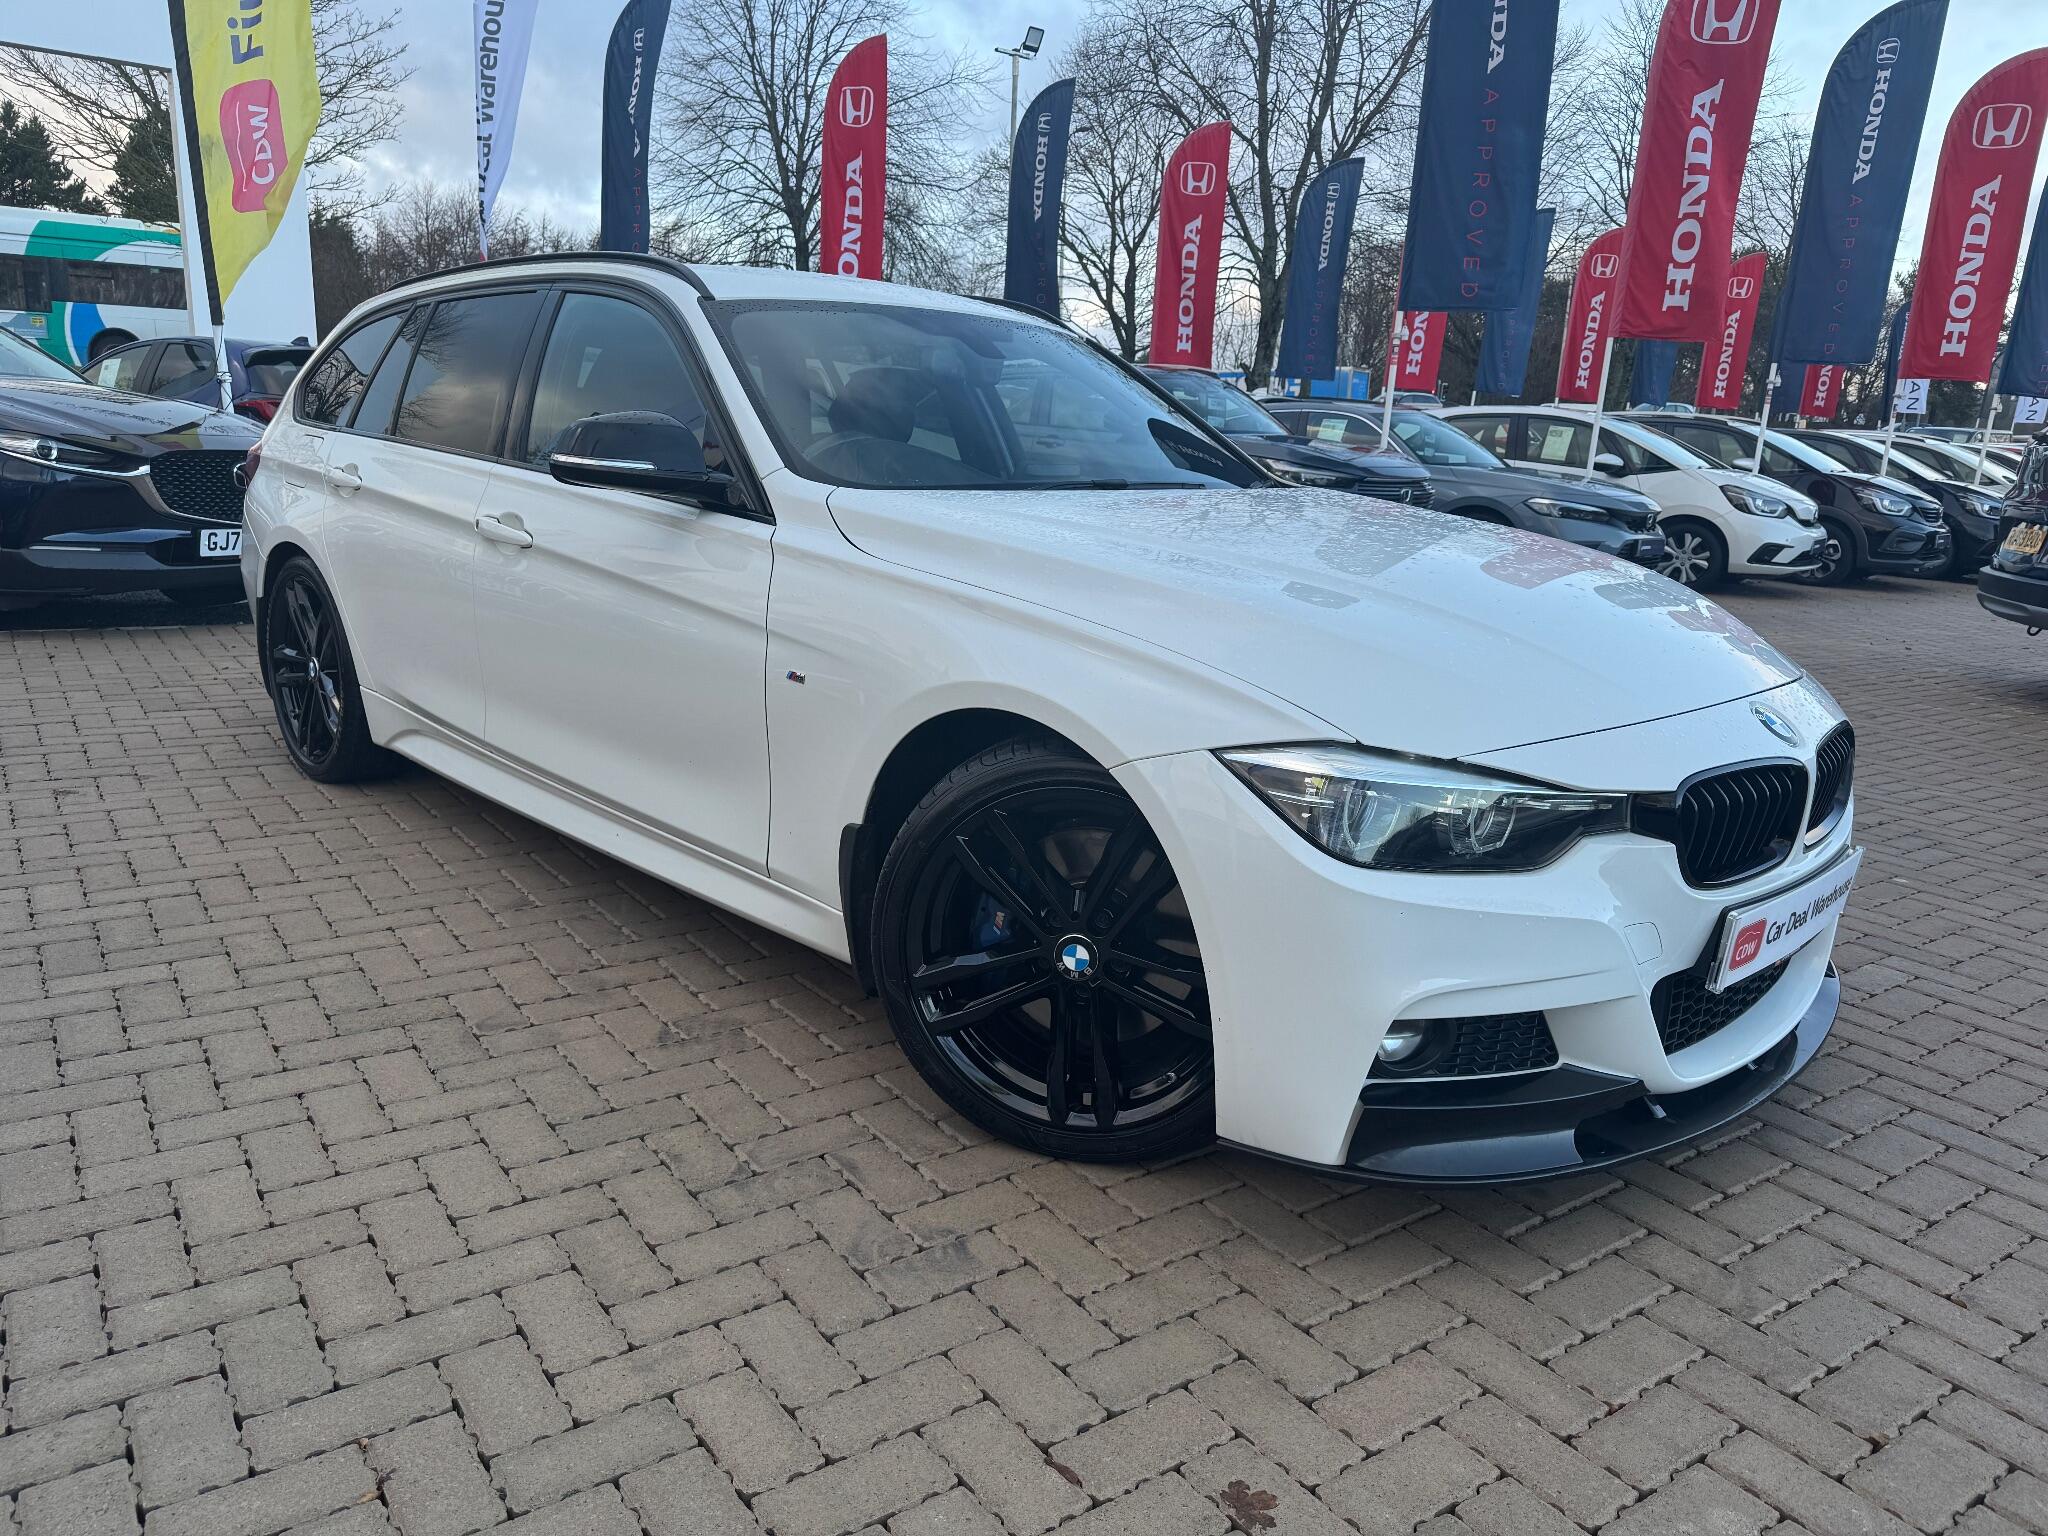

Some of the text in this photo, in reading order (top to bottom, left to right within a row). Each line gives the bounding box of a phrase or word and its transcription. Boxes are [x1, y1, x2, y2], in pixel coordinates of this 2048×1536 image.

[247, 104, 275, 185] CDW
[1853, 68, 1892, 184] HONDA
[1033, 134, 1049, 223] HONDA
[1460, 88, 1500, 298] APPROVED
[1661, 78, 1725, 312] HONDA
[1318, 200, 1336, 272] HONDA
[1939, 174, 2003, 358] HONDA
[1176, 214, 1203, 353] HONDA
[1575, 290, 1605, 390] HONDA
[1713, 309, 1741, 399] HONDA
[207, 531, 241, 552] GJ7
[1735, 939, 1758, 961] CDW
[1766, 920, 1787, 945] Car
[1785, 902, 1812, 936] Deal
[1056, 961, 1093, 979] BMW
